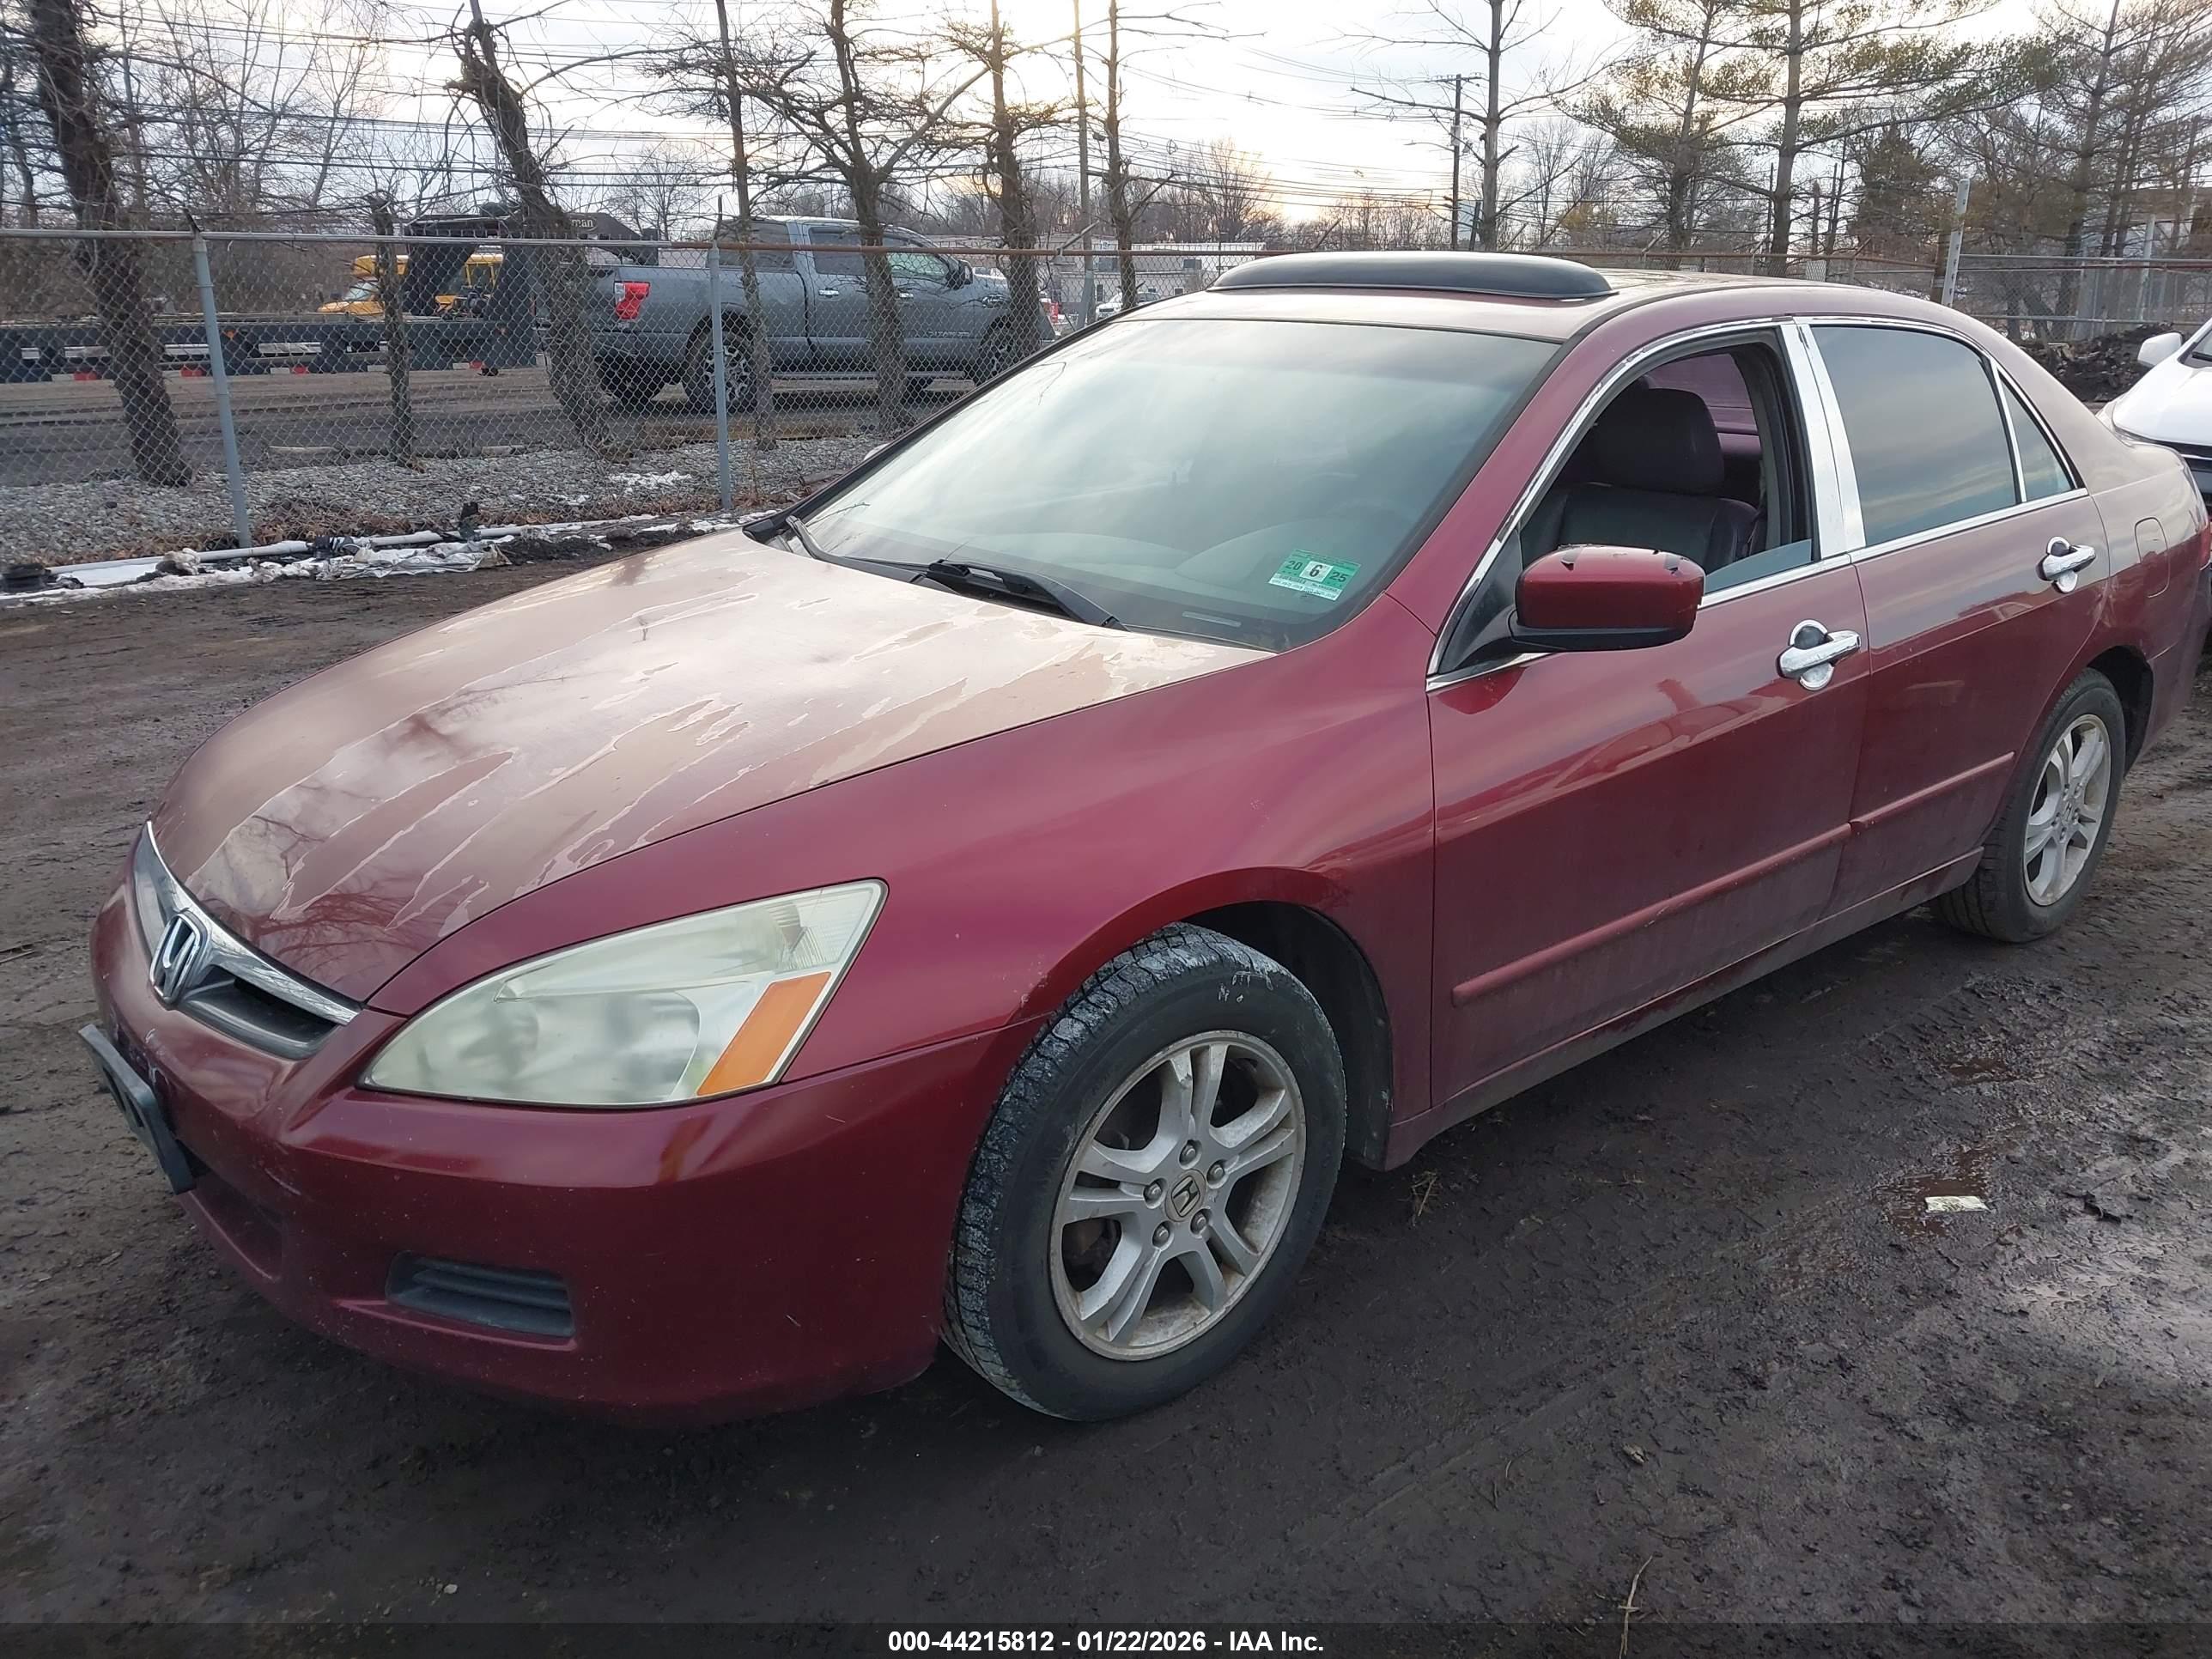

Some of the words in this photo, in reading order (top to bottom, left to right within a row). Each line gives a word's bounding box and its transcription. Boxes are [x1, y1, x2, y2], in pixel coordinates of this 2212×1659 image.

[1285, 560, 1303, 571] 20
[1310, 564, 1323, 577] 6
[1329, 571, 1347, 582] 25
